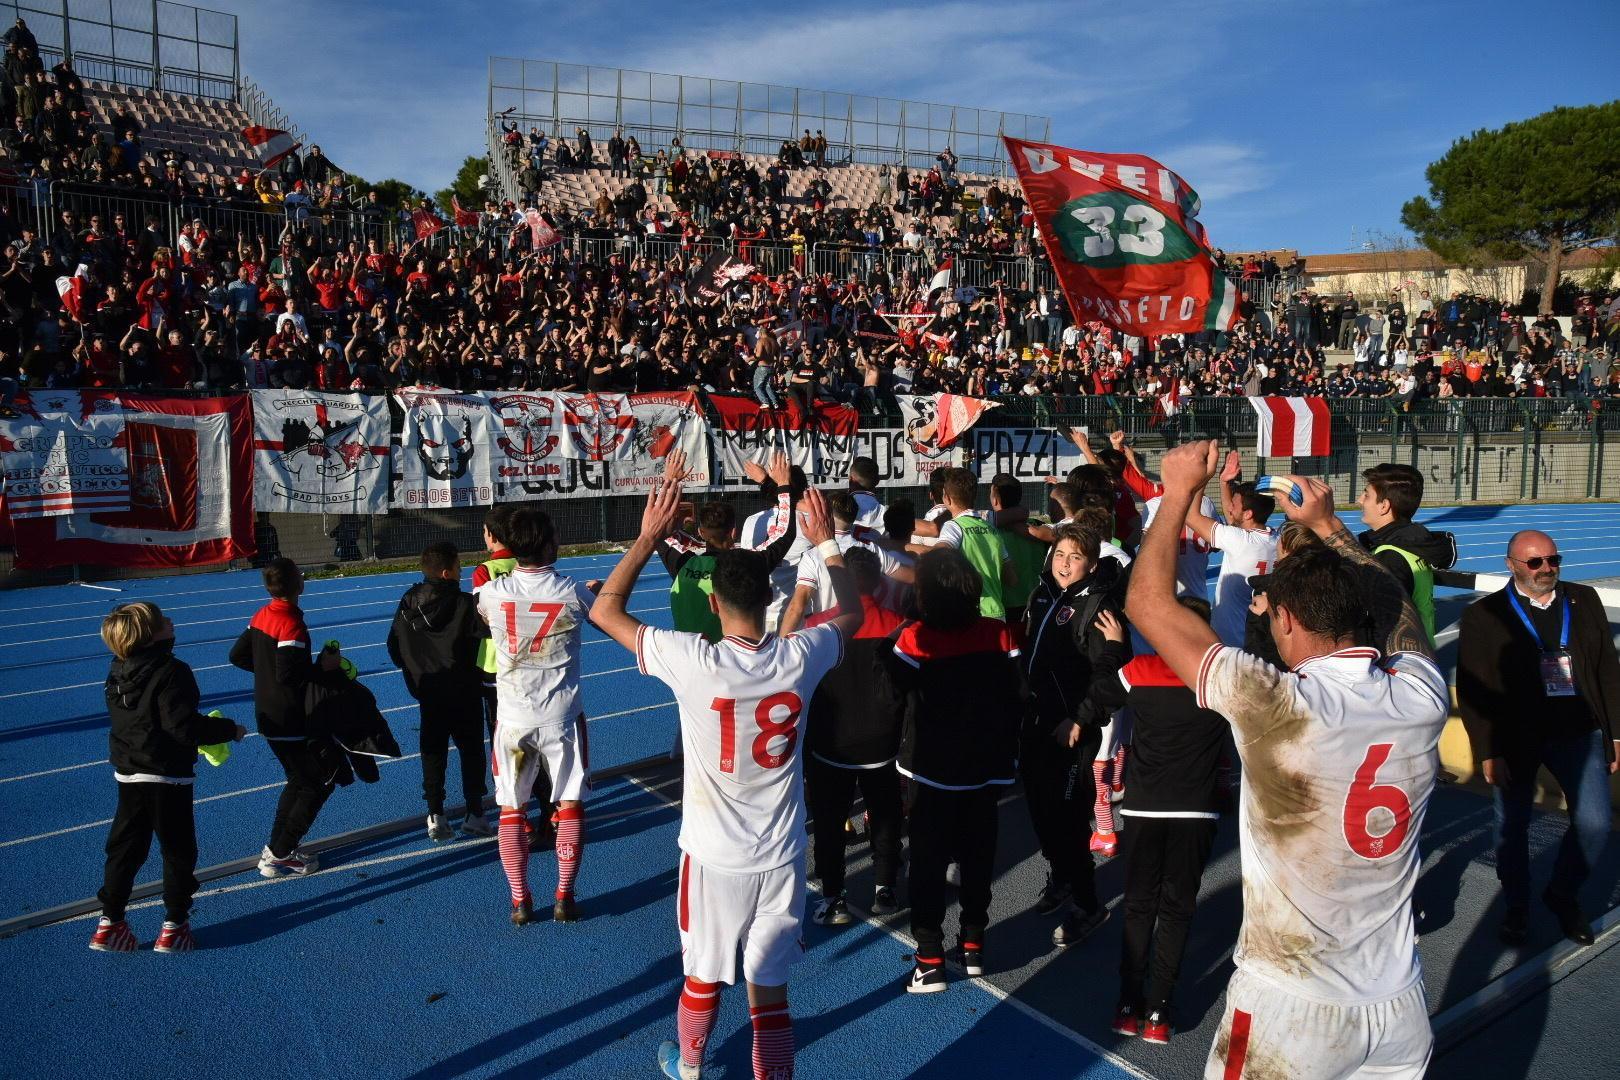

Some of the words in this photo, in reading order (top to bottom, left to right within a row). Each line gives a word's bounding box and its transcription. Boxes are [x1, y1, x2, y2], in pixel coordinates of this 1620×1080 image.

[1071, 204, 1166, 257] 33
[281, 399, 319, 407] VECCHIA
[519, 396, 551, 409] GUARDIA
[13, 435, 113, 451] GRUPPO
[12, 478, 122, 495] GROSSETO
[615, 476, 641, 487] CURVA
[643, 476, 664, 485] NORD
[293, 492, 312, 501] BAD
[325, 493, 350, 501] BOYS
[406, 487, 490, 504] GROSSETO
[500, 601, 567, 655] 17
[709, 691, 803, 774] 18
[1342, 742, 1412, 861] 6
